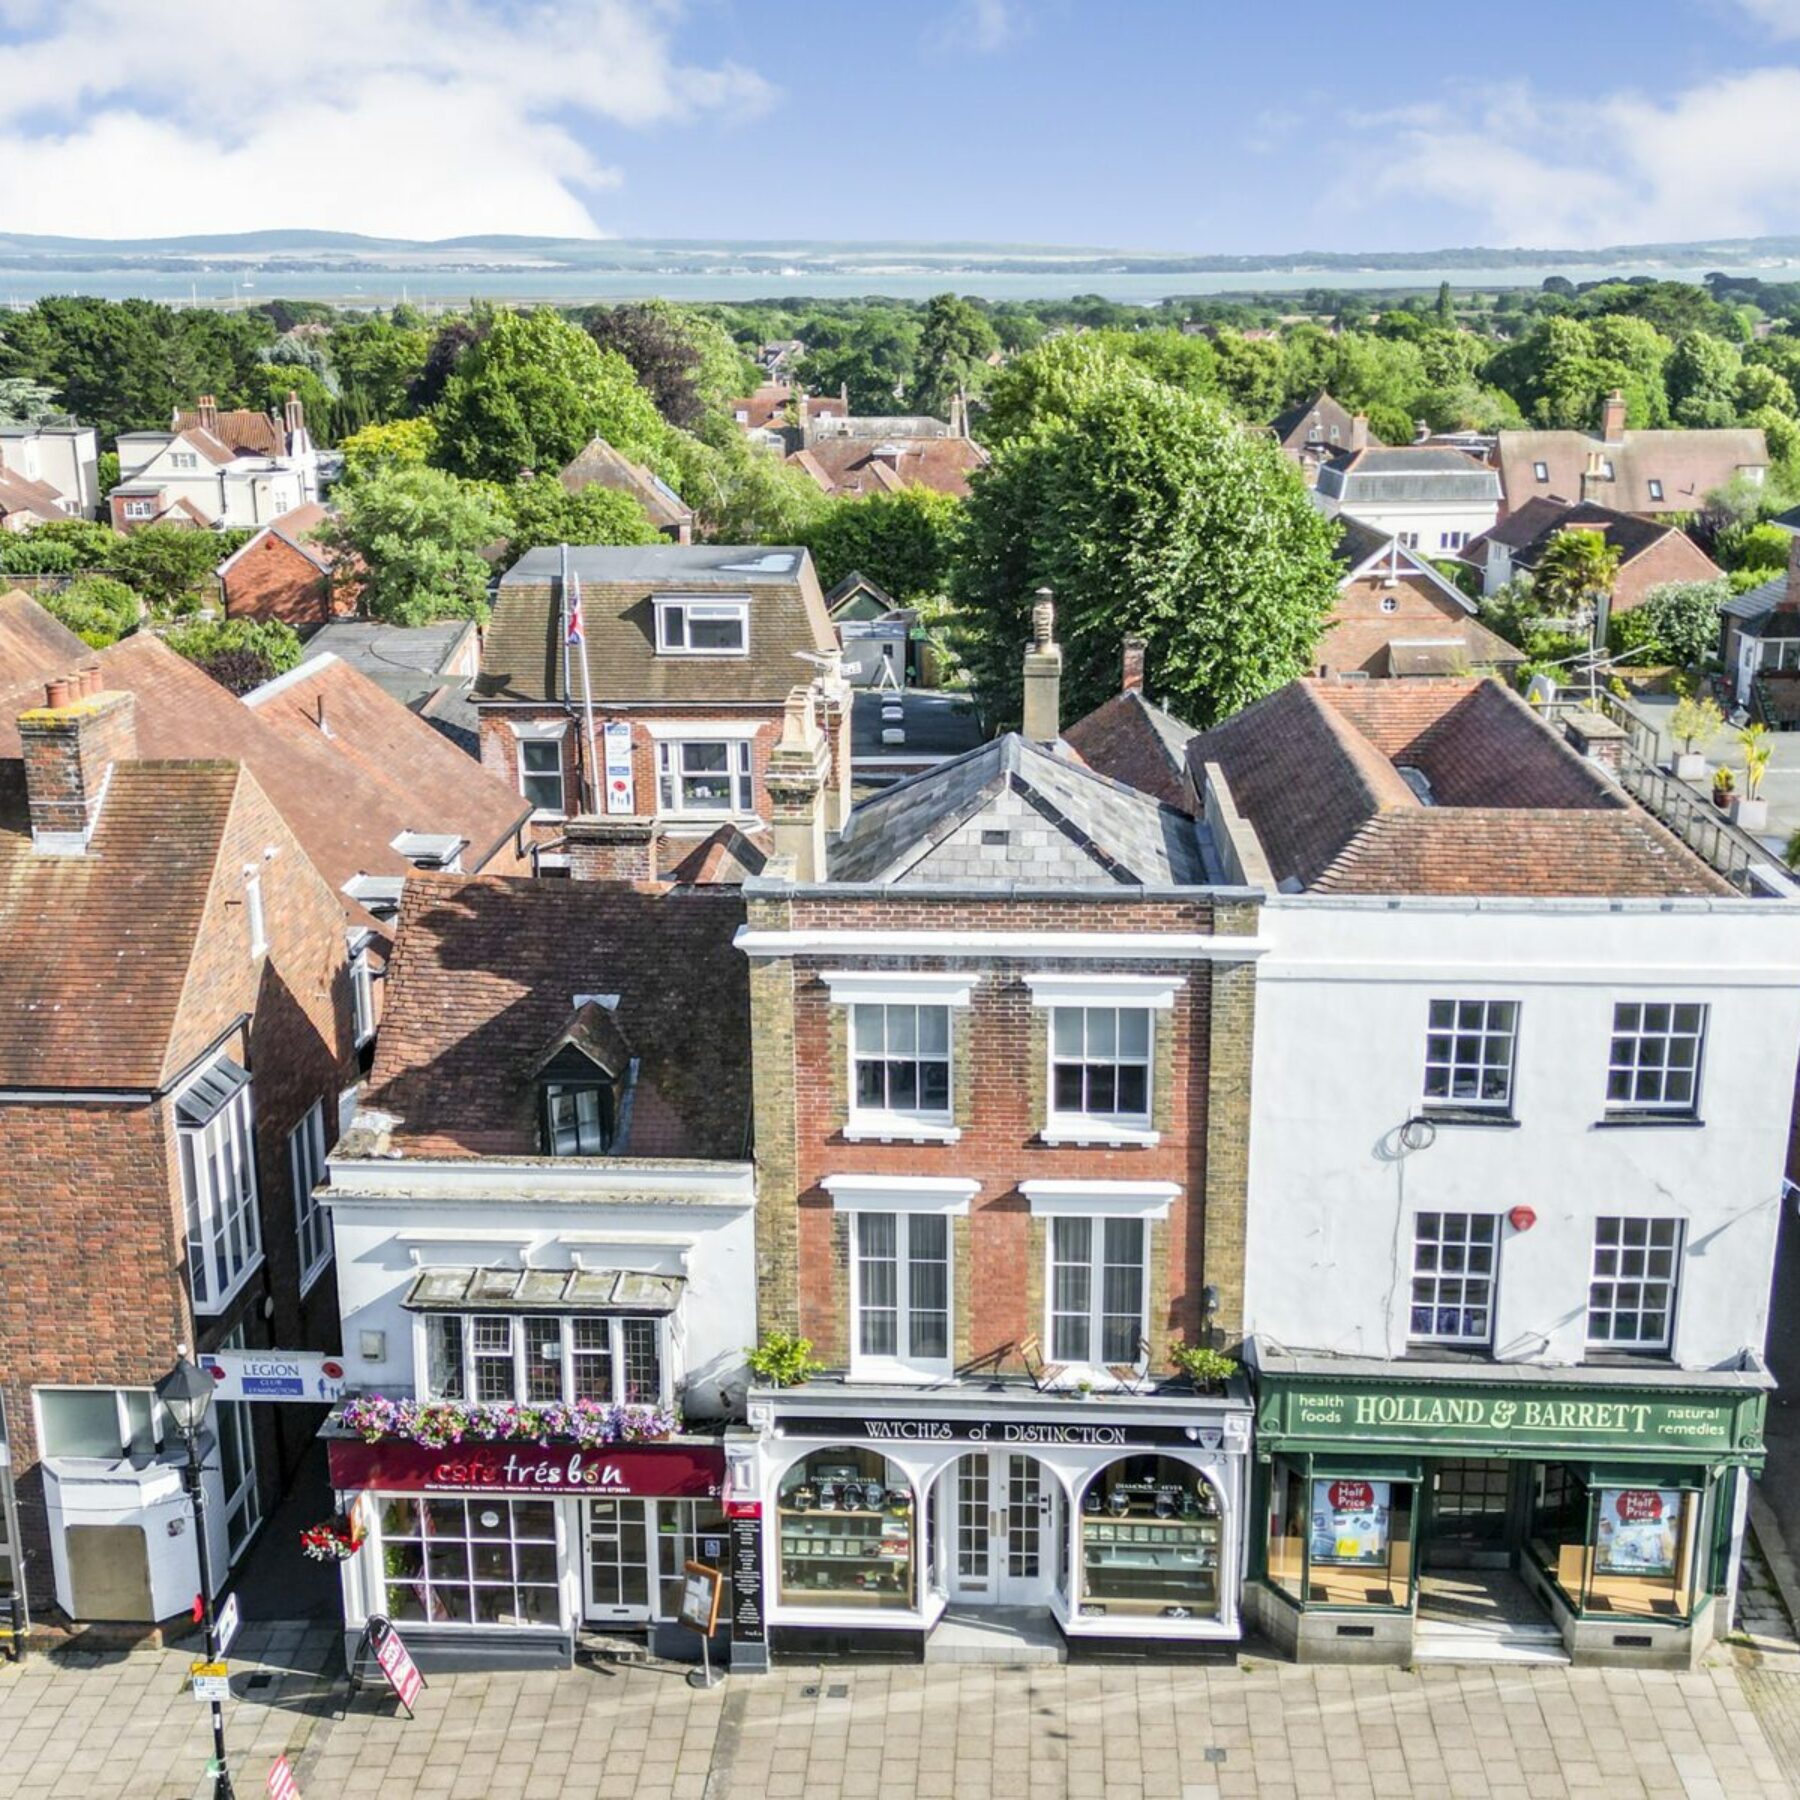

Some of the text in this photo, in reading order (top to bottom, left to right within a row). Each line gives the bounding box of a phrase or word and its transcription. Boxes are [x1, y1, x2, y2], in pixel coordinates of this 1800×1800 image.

[243, 1364, 299, 1376] LEGION
[1299, 1395, 1344, 1407] health
[1301, 1409, 1342, 1423] foods
[1355, 1396, 1651, 1433] HOLLAND & BARRETT
[1667, 1407, 1720, 1420] natural
[864, 1421, 1127, 1444] WATCHES of DISTINCTION
[1657, 1423, 1725, 1435] remedies
[1210, 1453, 1228, 1465] 23
[1338, 1487, 1366, 1497] Half
[1626, 1497, 1655, 1507] Half
